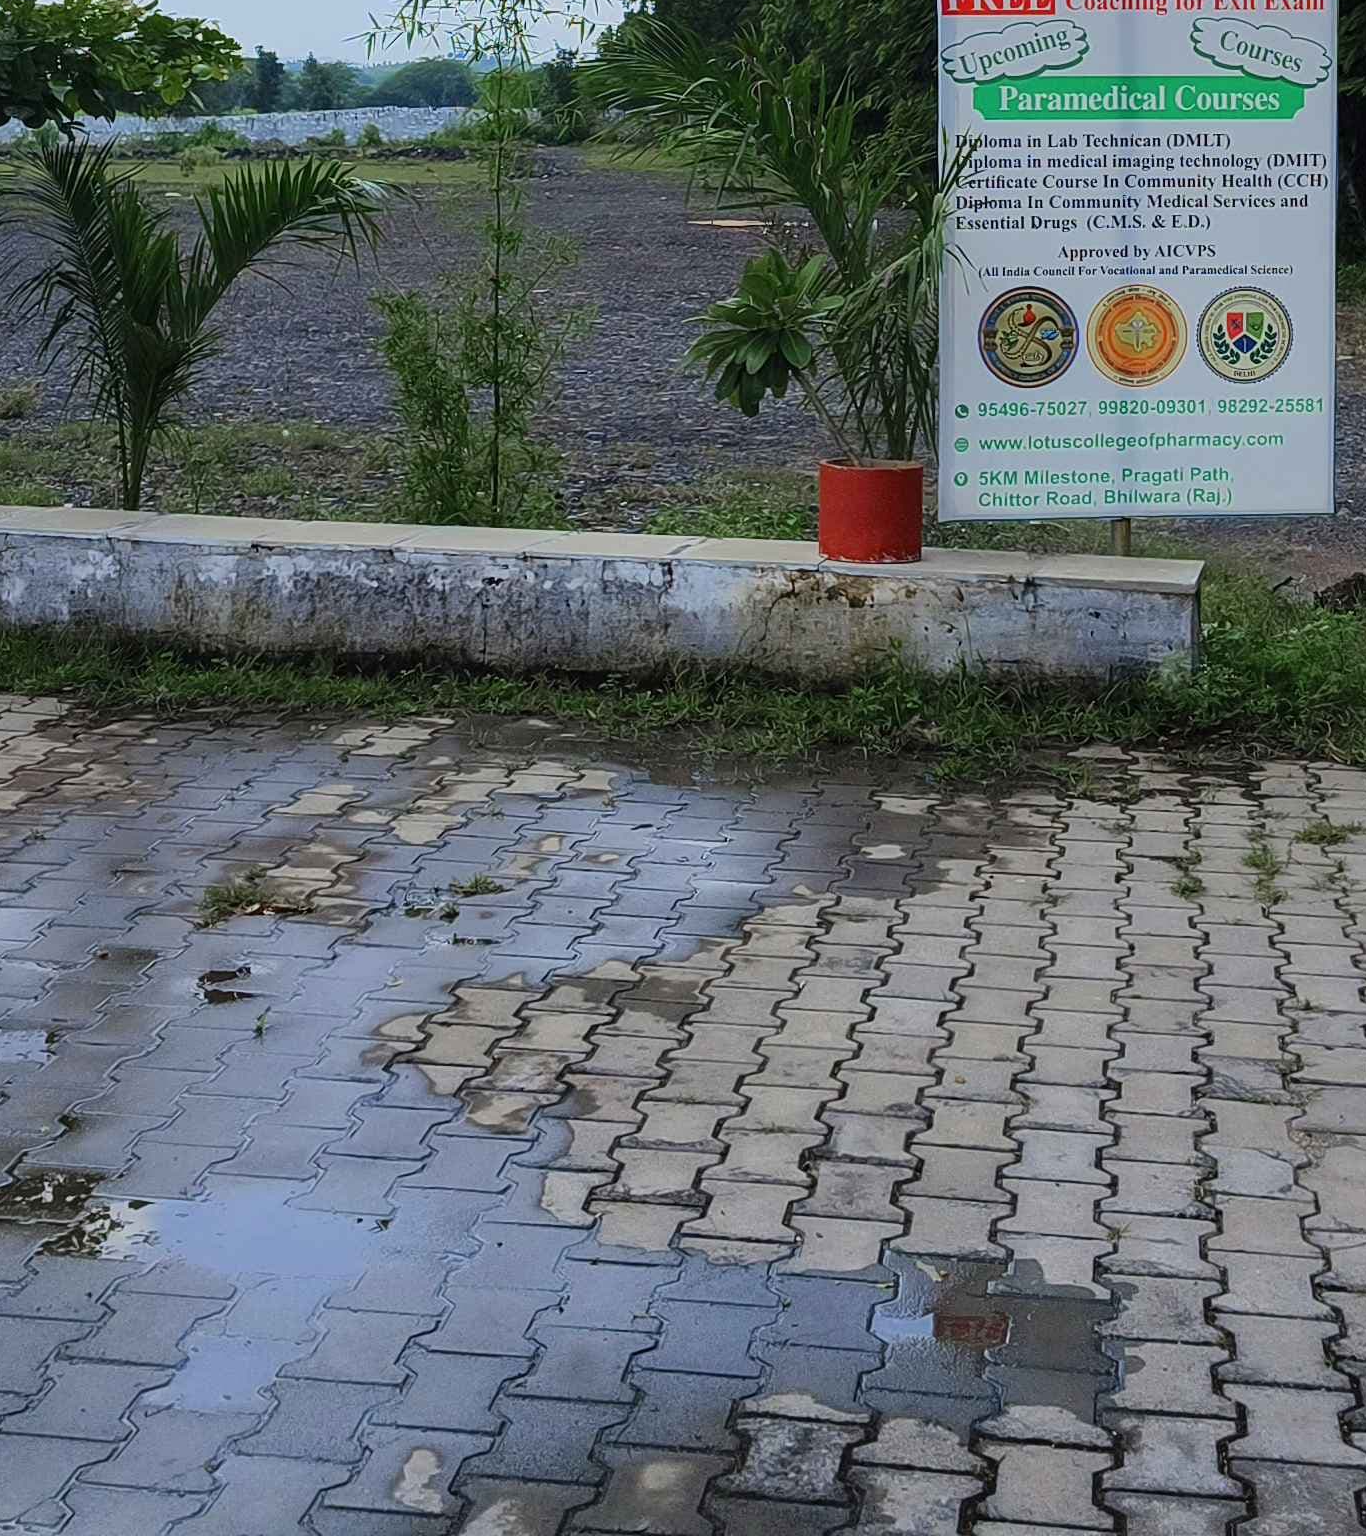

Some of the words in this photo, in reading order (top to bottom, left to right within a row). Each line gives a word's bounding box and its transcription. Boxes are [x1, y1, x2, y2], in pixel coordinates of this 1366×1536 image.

[959, 29, 1072, 75] Upcoming
[1220, 30, 1303, 73] Courses
[999, 85, 1166, 112] Paramedical
[1175, 84, 1281, 111] Courses
[1027, 135, 1041, 148] in
[1047, 134, 1077, 148] Lab
[1083, 134, 1162, 148] Technican
[1166, 133, 1231, 150] (DMLT)
[957, 154, 1022, 172] iploma
[1027, 155, 1041, 168] in
[1047, 154, 1107, 168] medical
[1113, 155, 1175, 171] imaging
[1180, 154, 1260, 171] technology
[1267, 153, 1327, 170] (DMIT)
[955, 175, 1038, 189] Certificate
[1042, 175, 1097, 189] Course
[1103, 175, 1119, 188] In
[1124, 175, 1216, 191] Community
[1222, 174, 1272, 188] Health
[1277, 173, 1328, 190] (CCH)
[956, 195, 1022, 213] Diploma
[1028, 195, 1043, 209] In
[1049, 195, 1142, 212] Community
[1147, 194, 1208, 209] Medical
[1213, 194, 1276, 208] Services
[1280, 194, 1308, 207] and
[955, 216, 1025, 230] Essential
[1031, 215, 1078, 232] Drugs
[1087, 215, 1146, 231] (C.M.S.
[1151, 214, 1166, 228] &
[1172, 214, 1211, 231] E.D.)
[1058, 245, 1129, 261] Approved
[1132, 244, 1150, 260] by
[1154, 244, 1217, 258] AICVPS
[978, 266, 999, 279] (All
[1002, 266, 1030, 277] India
[1034, 265, 1075, 277] Council
[1078, 266, 1097, 276] For
[1100, 265, 1155, 276] Vocational
[1159, 265, 1179, 276] and
[1182, 265, 1248, 276] Paramedical
[1250, 265, 1294, 277] Science)
[1218, 398, 1324, 414] 98292-25581
[979, 432, 1284, 451] www.lotuscollegeofpharmacy.com
[979, 470, 1018, 486] 5KM
[1024, 470, 1116, 486] Milestone,
[1122, 468, 1184, 486] Pragati
[979, 492, 1040, 507] Chittor
[1046, 491, 1097, 507] Road,
[1104, 489, 1181, 505] Bhilwara
[1186, 488, 1233, 506] (Raj.)
